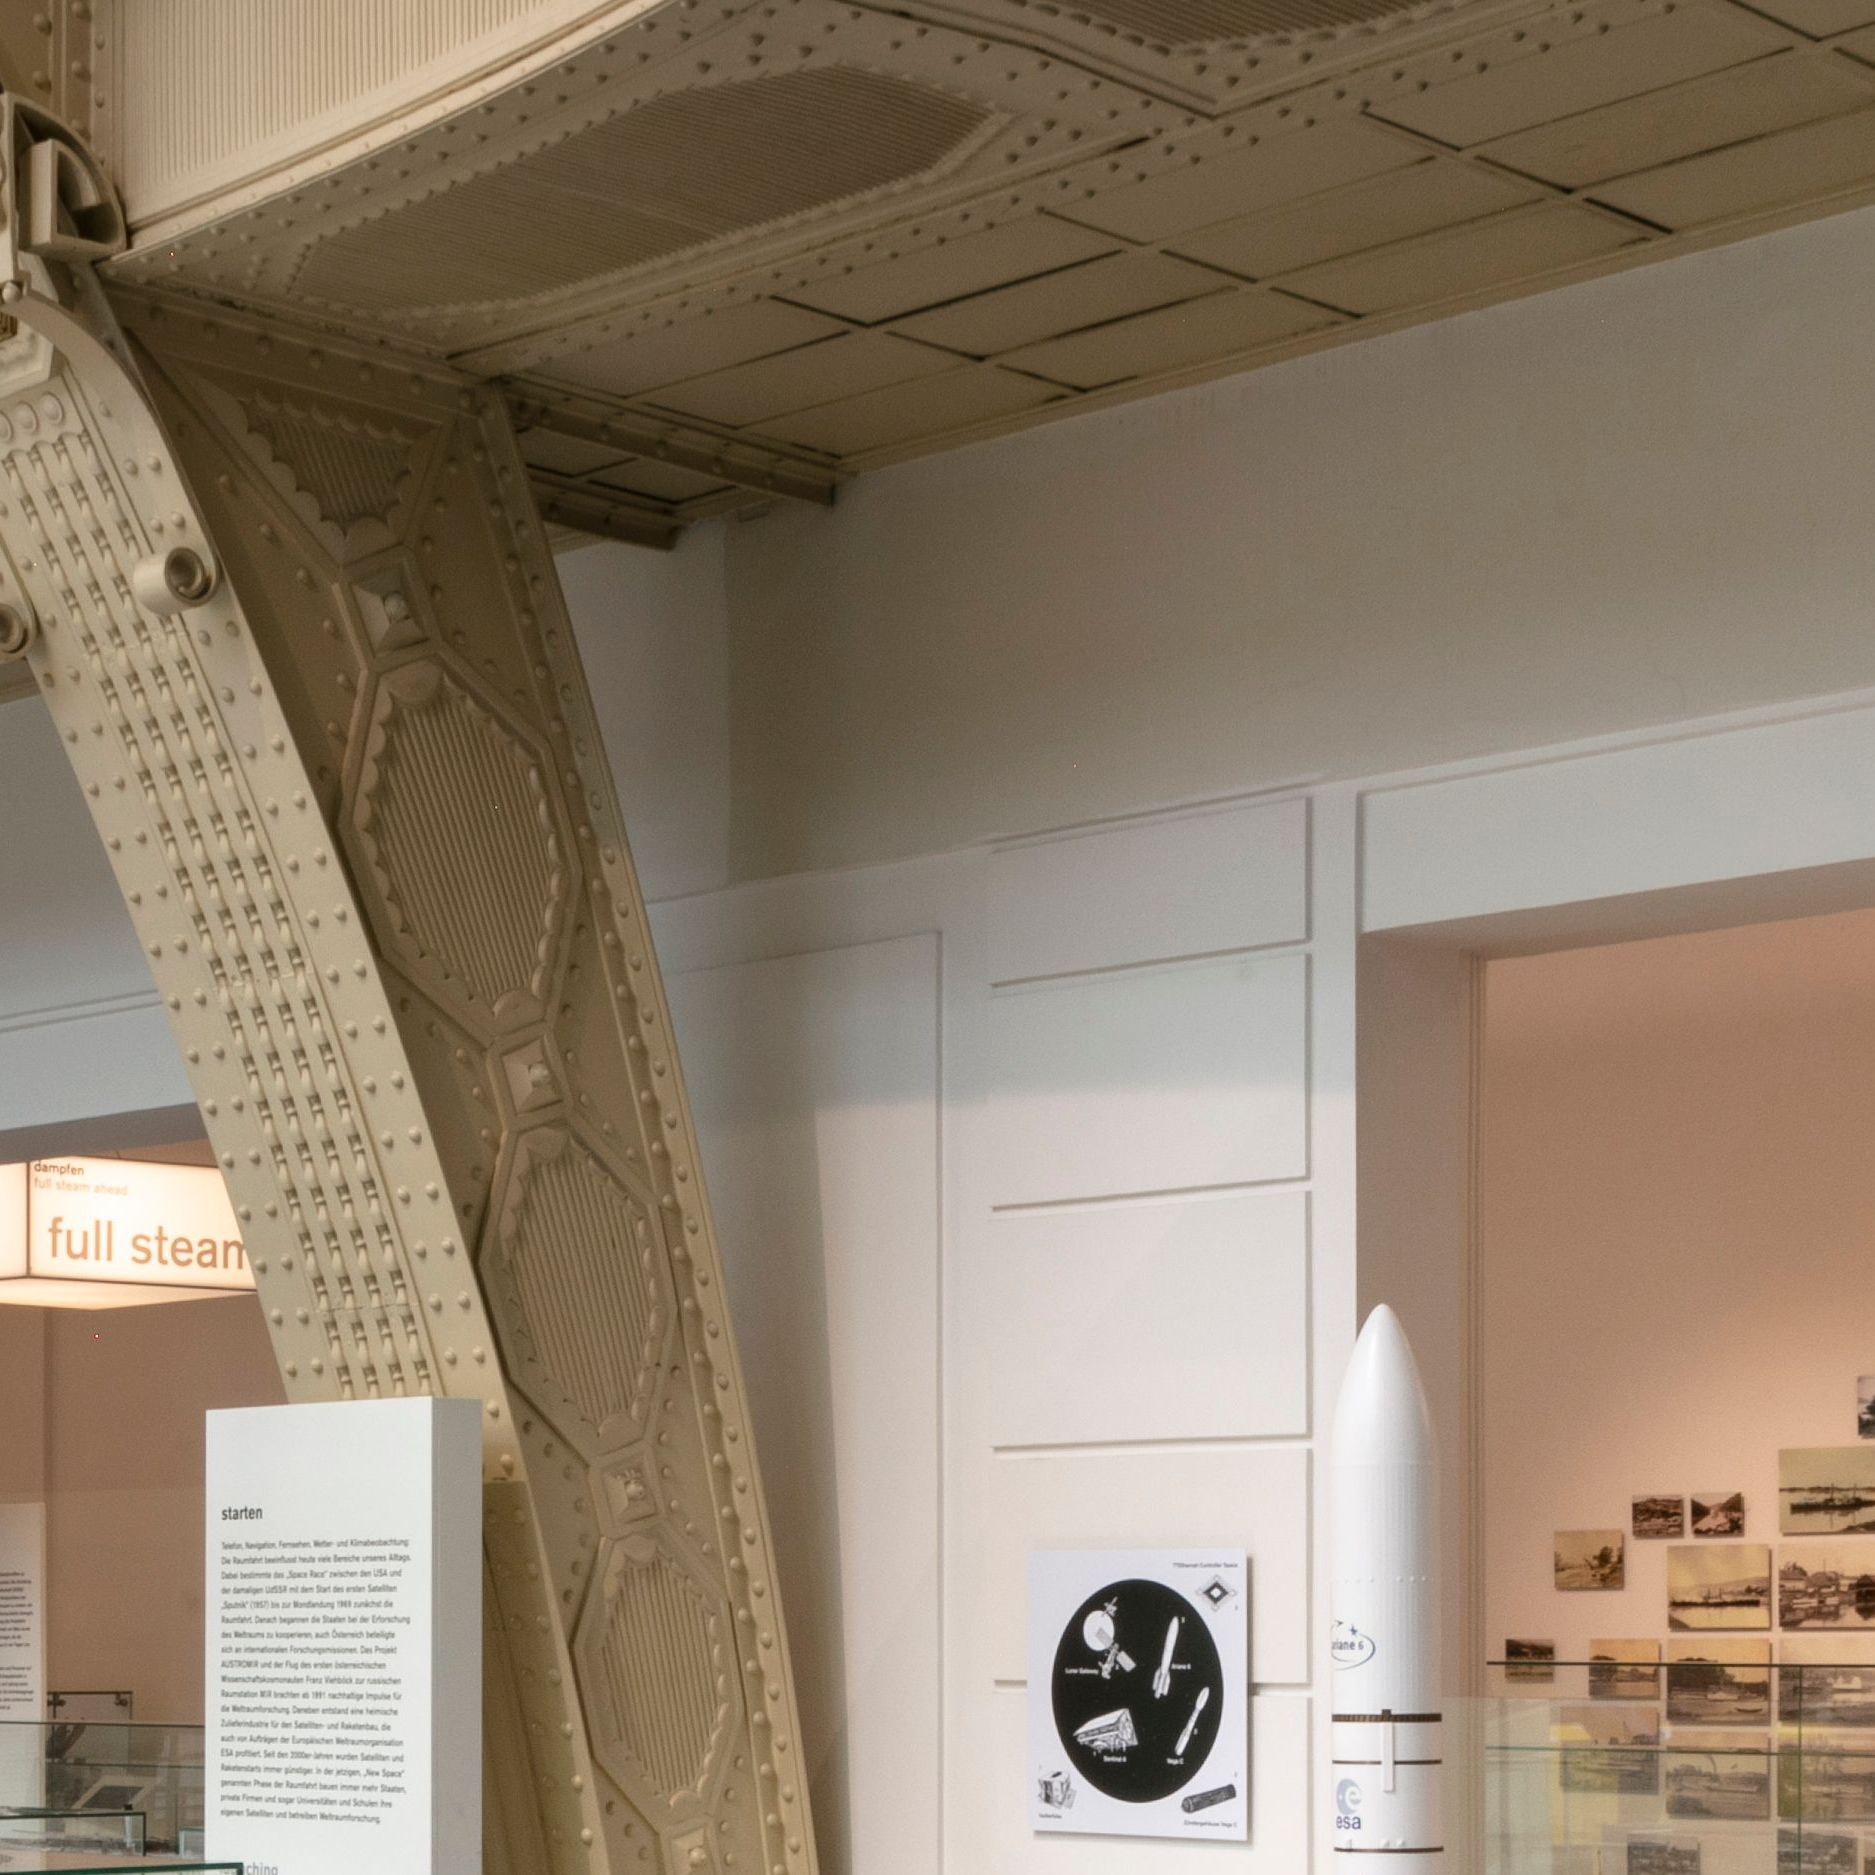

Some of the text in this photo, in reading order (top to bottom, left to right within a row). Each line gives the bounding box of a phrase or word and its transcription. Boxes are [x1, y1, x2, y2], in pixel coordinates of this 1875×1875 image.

[34, 1161, 85, 1177] dampfen
[34, 1177, 128, 1196] full steam ahead
[48, 1215, 113, 1263] full
[221, 1505, 263, 1521] starten
[337, 1539, 349, 1548] und
[221, 1557, 232, 1565] Die
[233, 1556, 264, 1565] Raumfahrt
[264, 1555, 298, 1564] beeinflusst
[299, 1555, 316, 1564] heute
[318, 1555, 332, 1563] viele
[334, 1554, 360, 1563] Bereiche
[389, 1554, 411, 1564] Alltags.
[240, 1571, 272, 1579] bestimmte
[274, 1571, 285, 1579] das
[330, 1569, 358, 1578] zwischen
[360, 1569, 372, 1578] den
[374, 1569, 388, 1578] USA
[390, 1569, 402, 1577] und
[221, 1586, 232, 1595] der
[233, 1586, 264, 1596] damaligen
[289, 1585, 299, 1594] mit
[301, 1585, 314, 1594] dem
[317, 1585, 331, 1594] Start
[333, 1585, 344, 1593] des
[346, 1585, 366, 1593] ersten
[368, 1584, 397, 1593] Satelliten
[271, 1601, 280, 1609] bis
[293, 1601, 335, 1611] Mondlandung
[384, 1600, 393, 1608] die
[221, 1615, 411, 1625] Raumfahrt. Danach begannen die Staaten bei der Erforschung
[1336, 1814, 1362, 1829] esa
